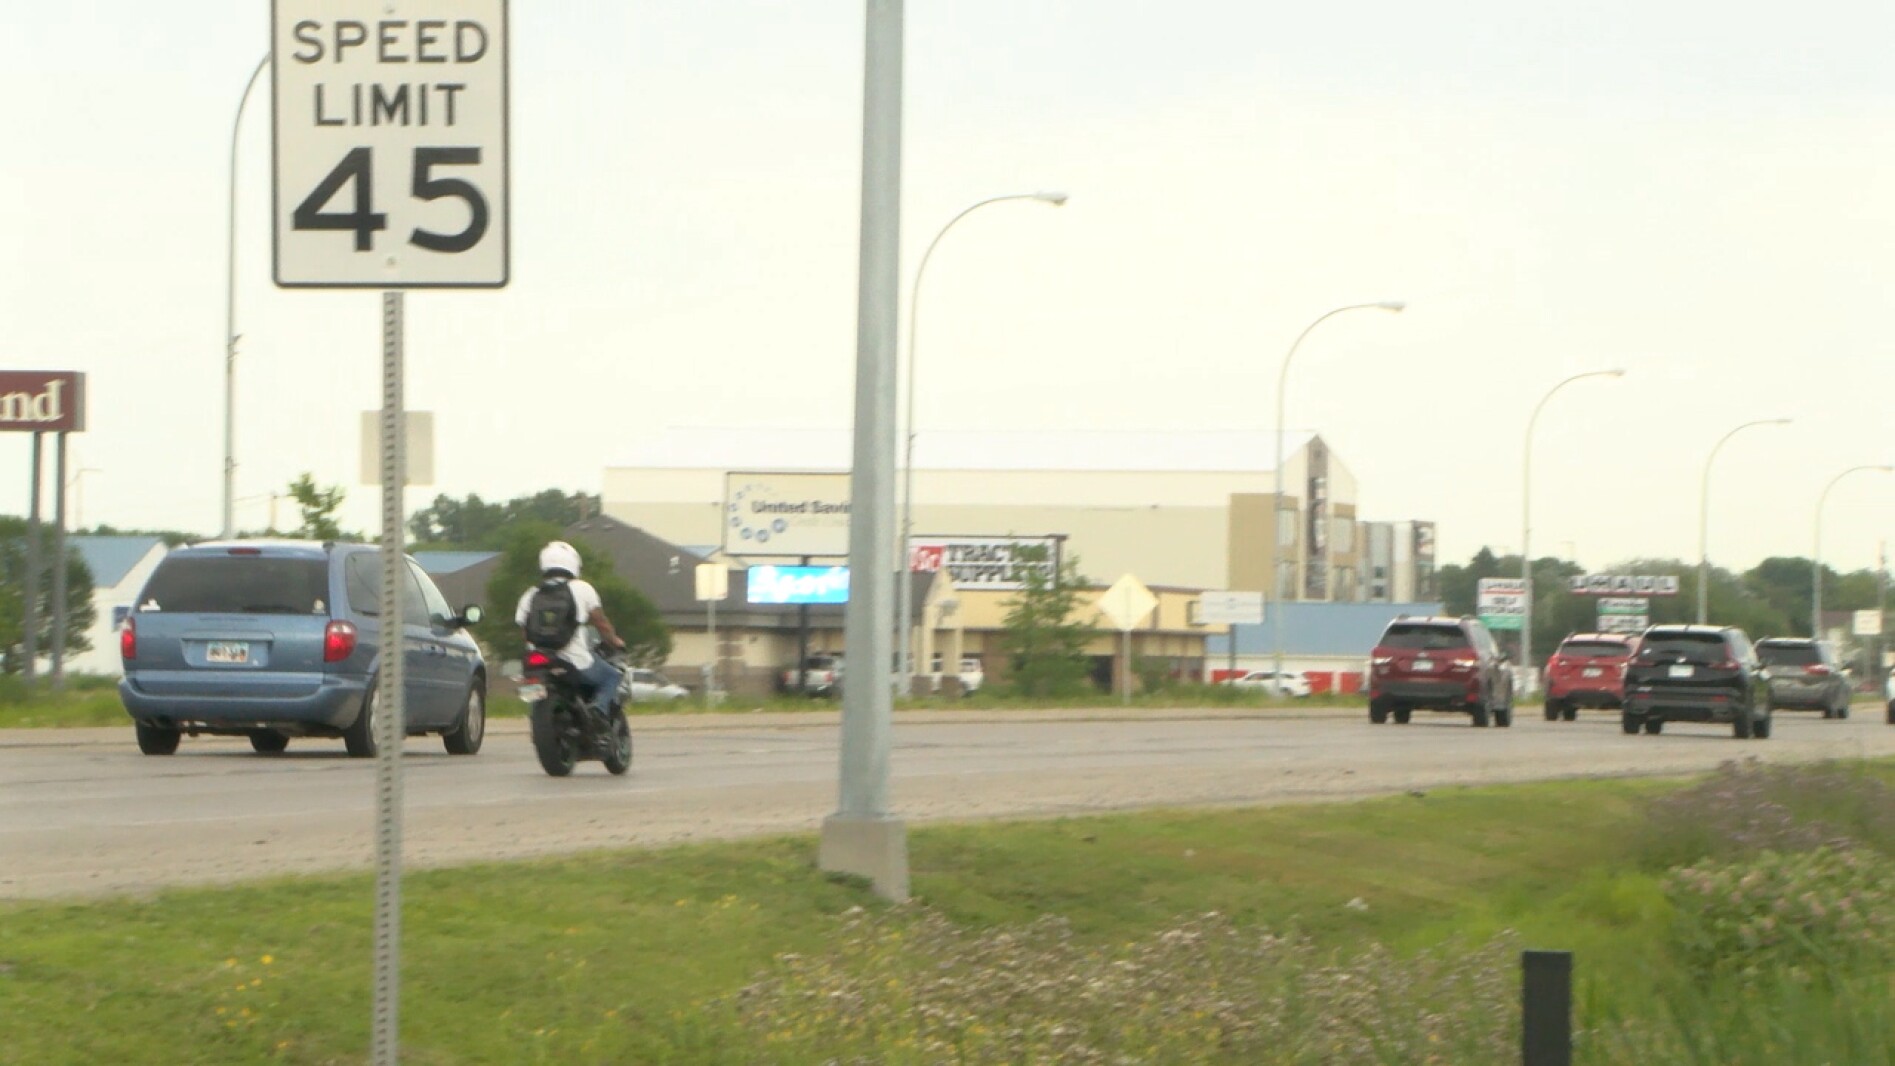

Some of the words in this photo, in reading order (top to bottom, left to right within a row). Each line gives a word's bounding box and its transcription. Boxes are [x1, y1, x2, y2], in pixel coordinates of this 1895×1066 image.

[292, 20, 488, 65] SPEED
[314, 83, 466, 127] LIMIT
[291, 146, 490, 253] 45
[0, 379, 66, 422] nd
[752, 500, 807, 513] United
